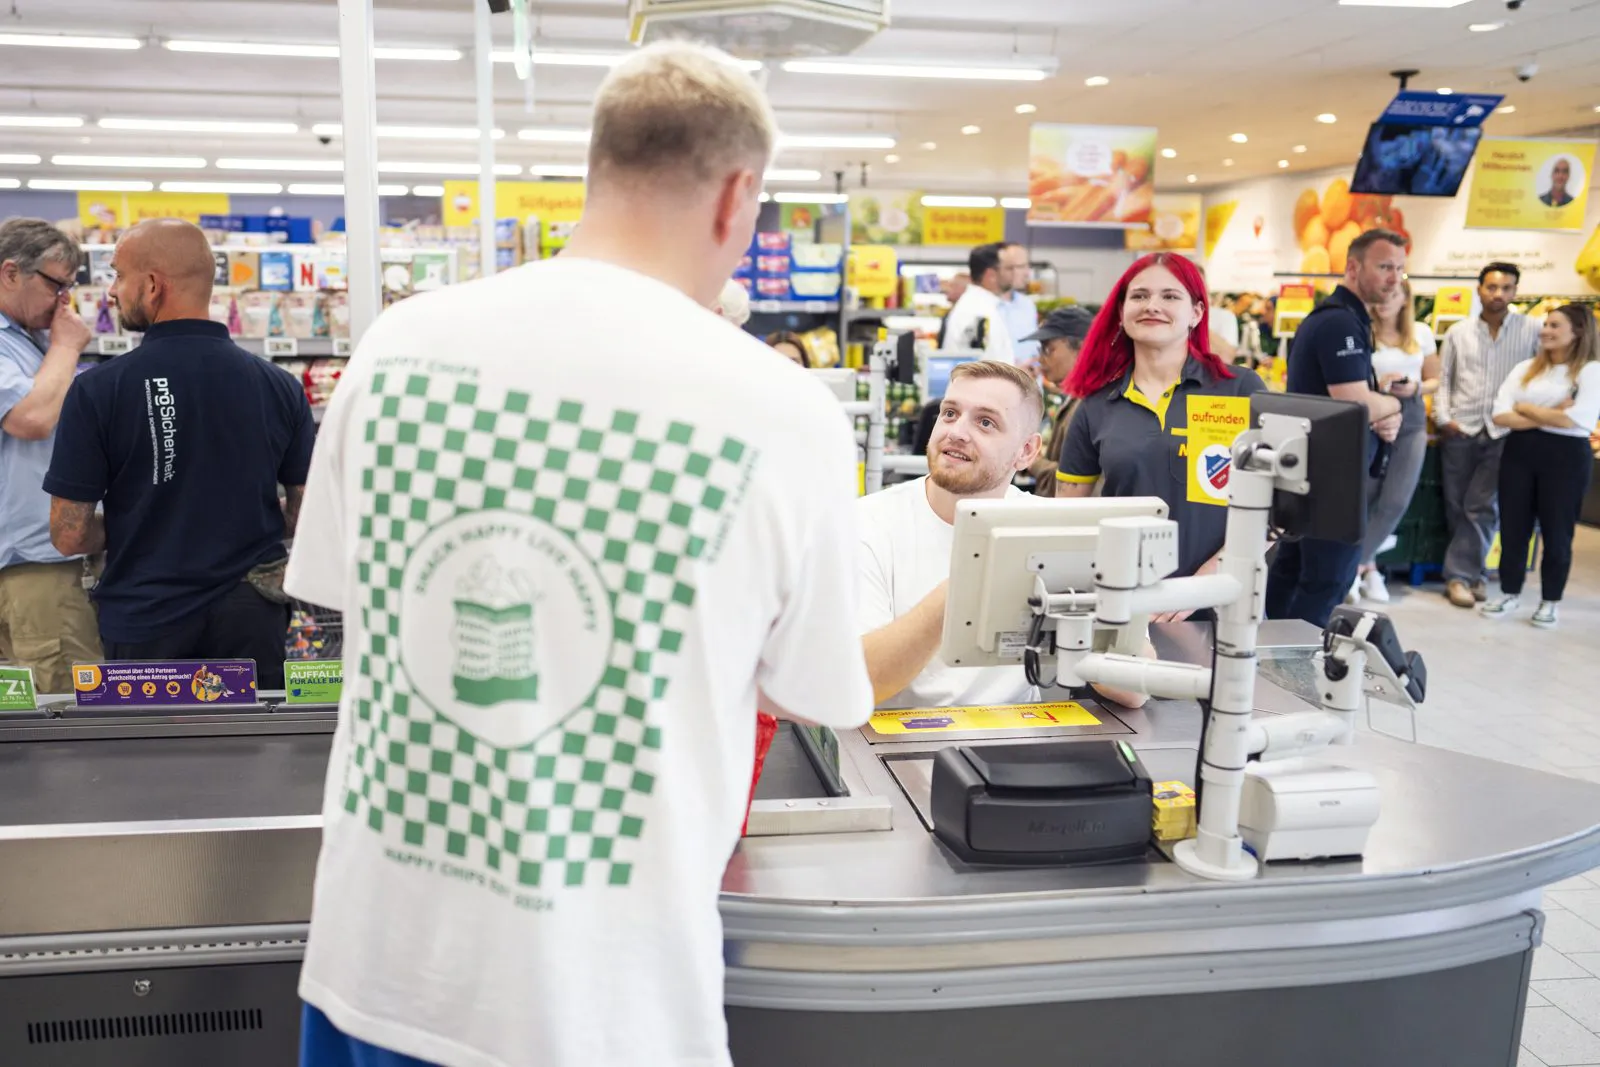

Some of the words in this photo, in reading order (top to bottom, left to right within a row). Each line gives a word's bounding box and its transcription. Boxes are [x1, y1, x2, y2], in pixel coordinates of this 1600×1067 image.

[1191, 412, 1246, 425] aufrunden
[460, 525, 522, 542] HAPPY
[384, 848, 437, 872] HAPPY
[439, 860, 486, 888] CHIPS
